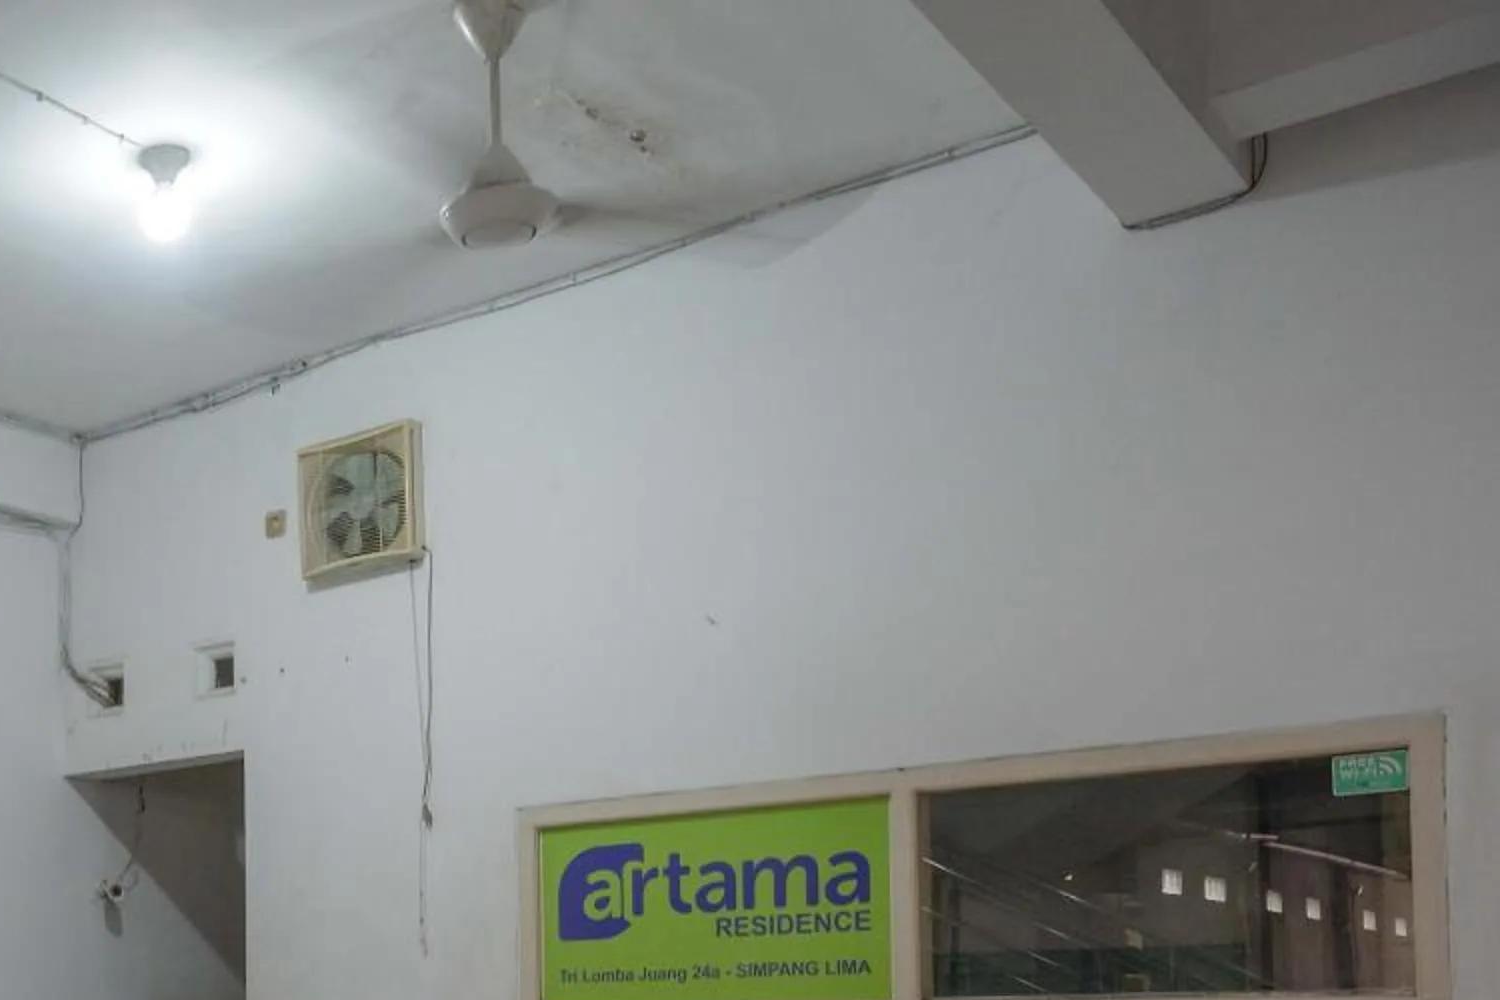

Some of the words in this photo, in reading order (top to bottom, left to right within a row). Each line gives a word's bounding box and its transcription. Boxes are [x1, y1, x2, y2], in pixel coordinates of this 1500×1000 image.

[715, 910, 871, 938] RESIDENCE
[582, 966, 634, 984] Lomba
[638, 966, 688, 983] Juang
[736, 960, 819, 978] SIMPANG
[825, 959, 872, 976] LIMA
